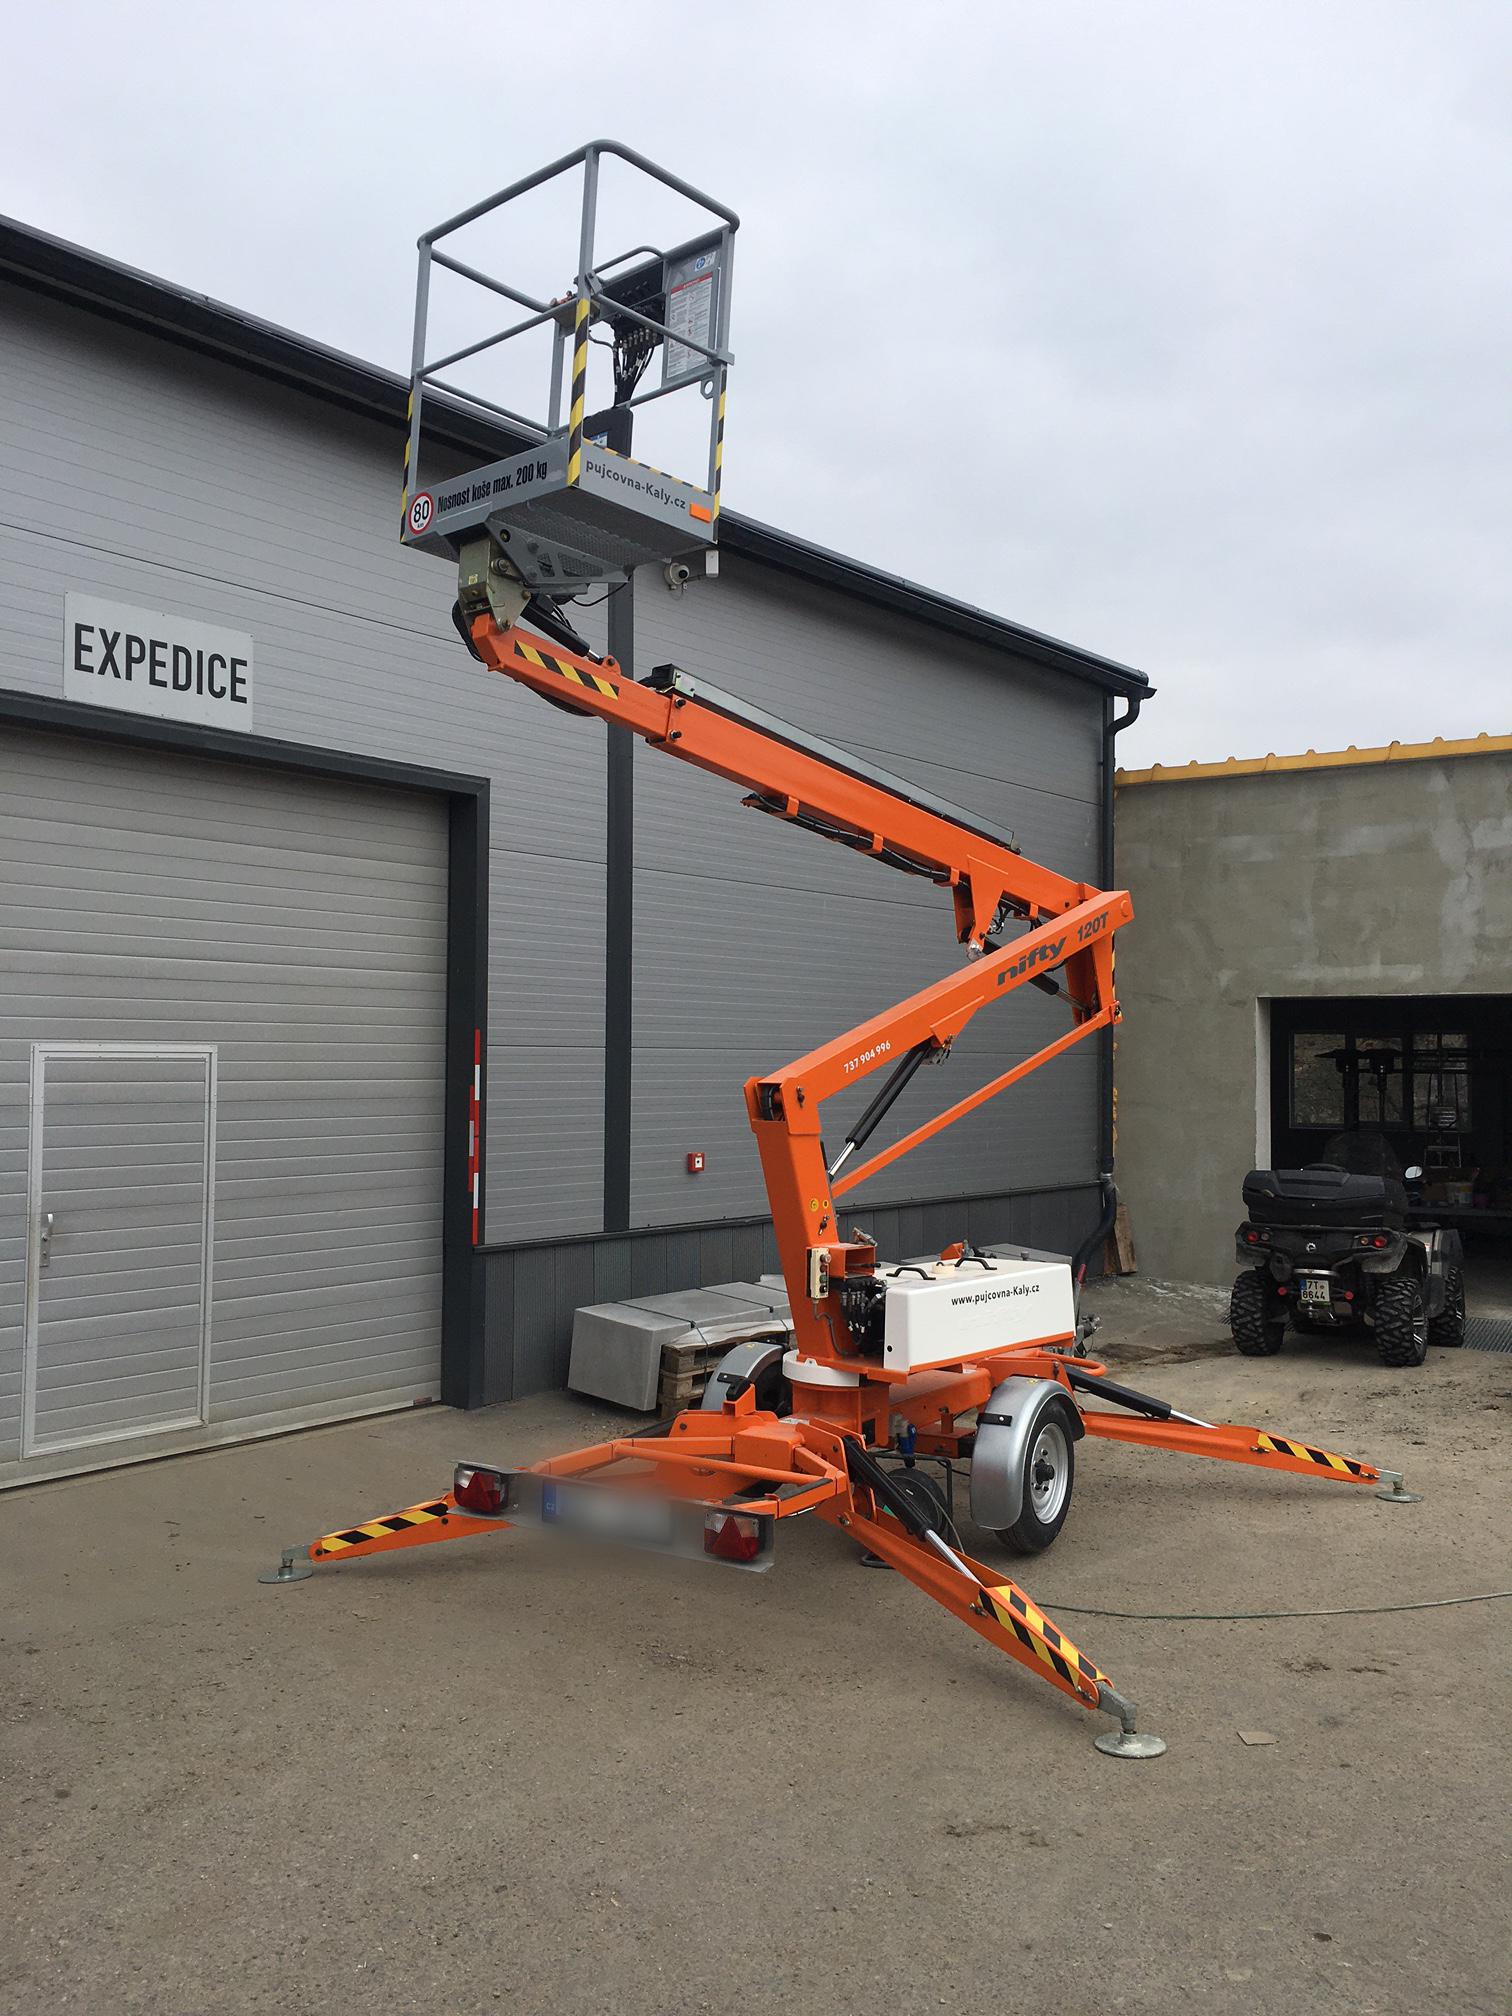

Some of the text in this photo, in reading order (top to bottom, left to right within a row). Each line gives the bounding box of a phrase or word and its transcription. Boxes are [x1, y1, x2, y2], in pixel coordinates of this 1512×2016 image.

[437, 461, 548, 513] Nosnost koše max. 200 kg
[586, 460, 686, 509] pujcovna-Kaly.cz
[413, 500, 430, 523] 80
[74, 622, 248, 704] EXPEDICE
[997, 911, 1109, 986] nifty 120T
[843, 1039, 891, 1074] 737 904 996
[951, 1284, 1040, 1306] www.pujcovna-Kaly.cz
[1307, 1280, 1319, 1290] 7T
